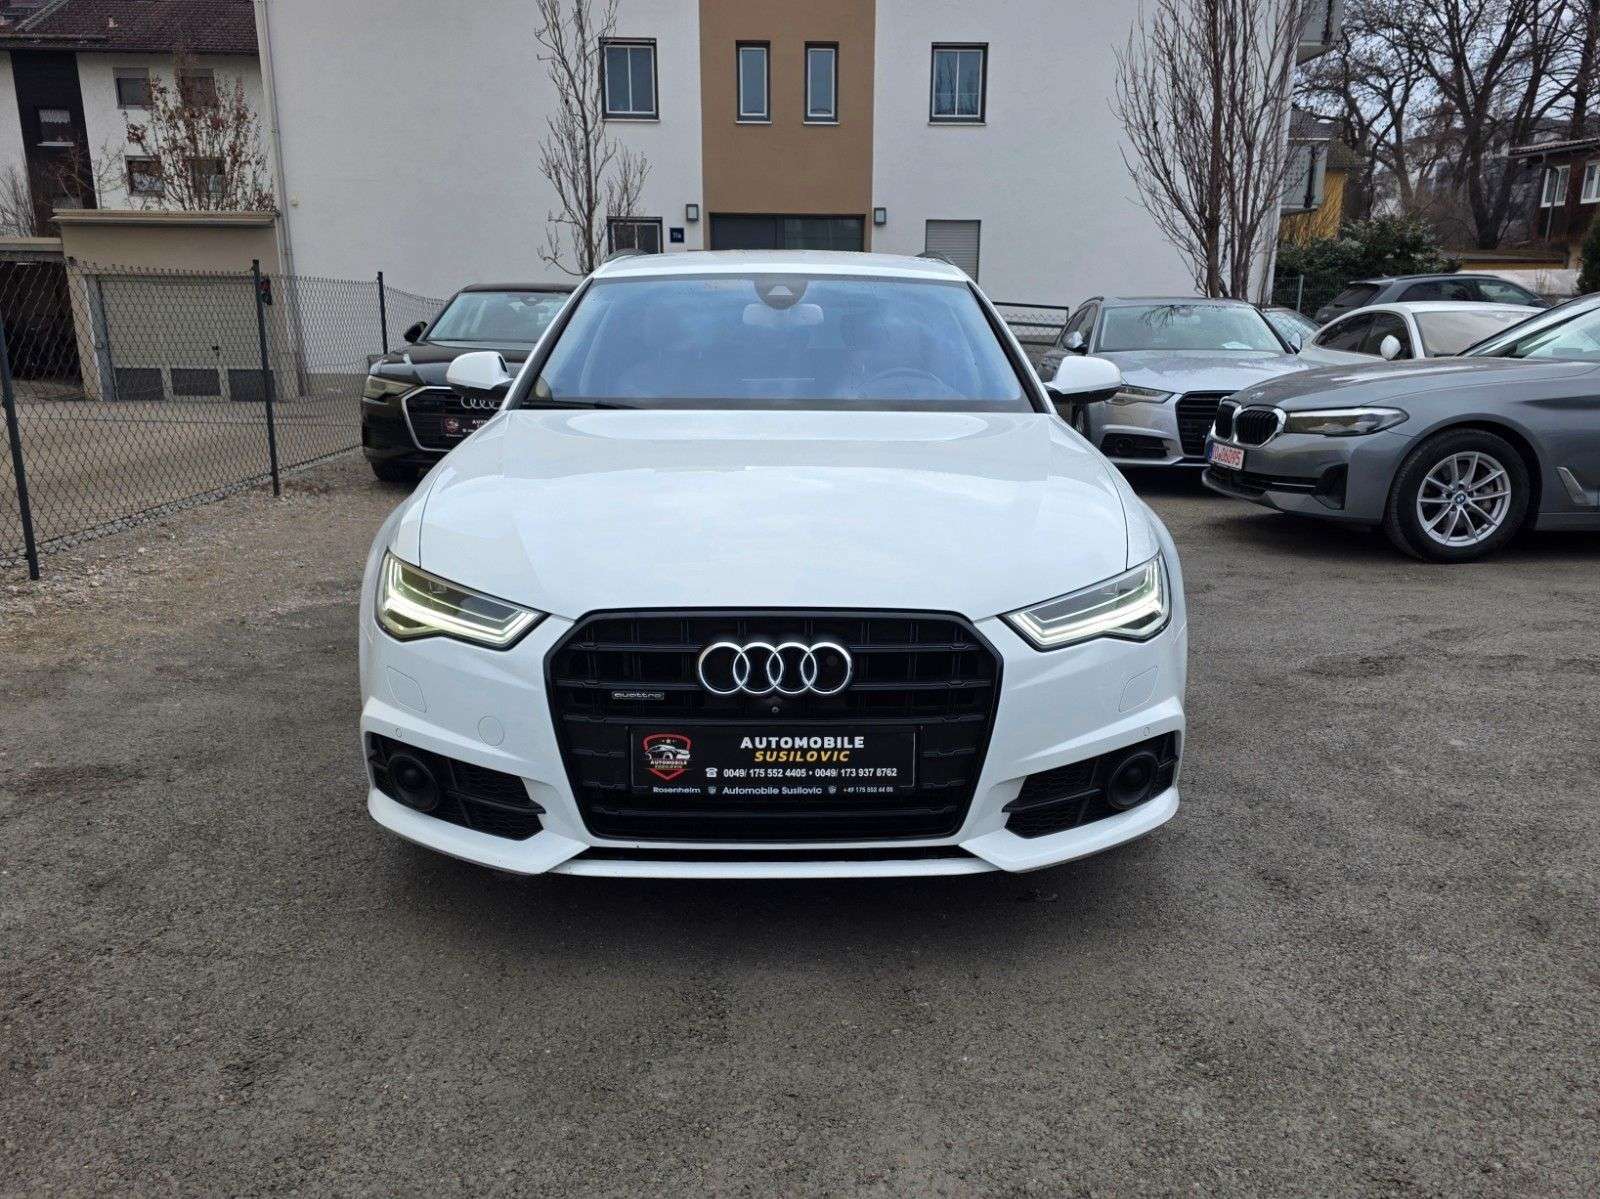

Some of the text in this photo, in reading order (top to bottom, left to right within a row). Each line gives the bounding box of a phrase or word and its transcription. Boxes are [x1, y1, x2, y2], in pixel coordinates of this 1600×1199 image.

[740, 736, 865, 749] AUTOMOBILE
[754, 750, 850, 762] SUSILOVIC
[749, 768, 765, 777] 175
[767, 768, 783, 777] 552
[785, 768, 807, 777] 4405
[841, 768, 856, 777] 173
[858, 768, 874, 777] 937
[653, 786, 701, 794] Rosenheim
[722, 786, 822, 795] Automobile Susilovic
